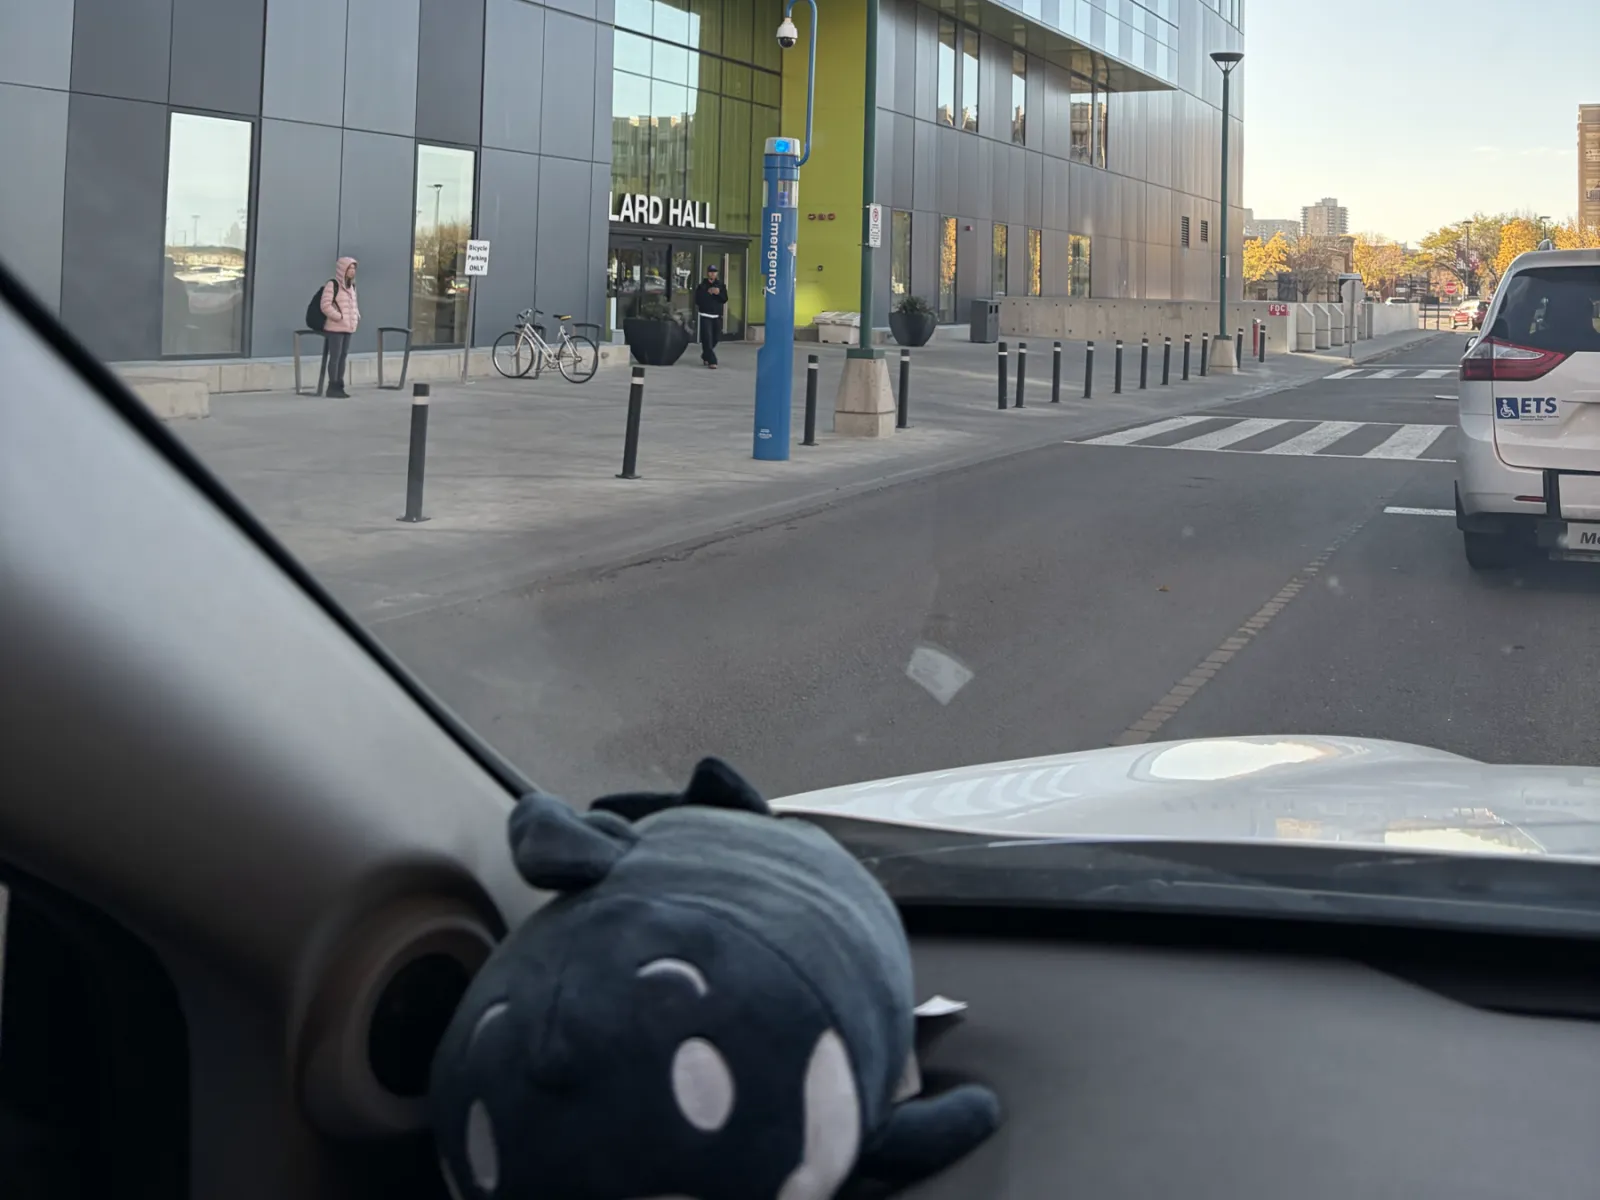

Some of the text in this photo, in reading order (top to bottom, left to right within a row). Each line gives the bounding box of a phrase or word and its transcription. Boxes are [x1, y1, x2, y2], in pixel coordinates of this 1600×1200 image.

[669, 198, 716, 229] HALL
[469, 244, 488, 252] Bicycle
[766, 213, 782, 295] Emergency
[468, 254, 487, 263] Parking
[1520, 397, 1557, 414] ETS
